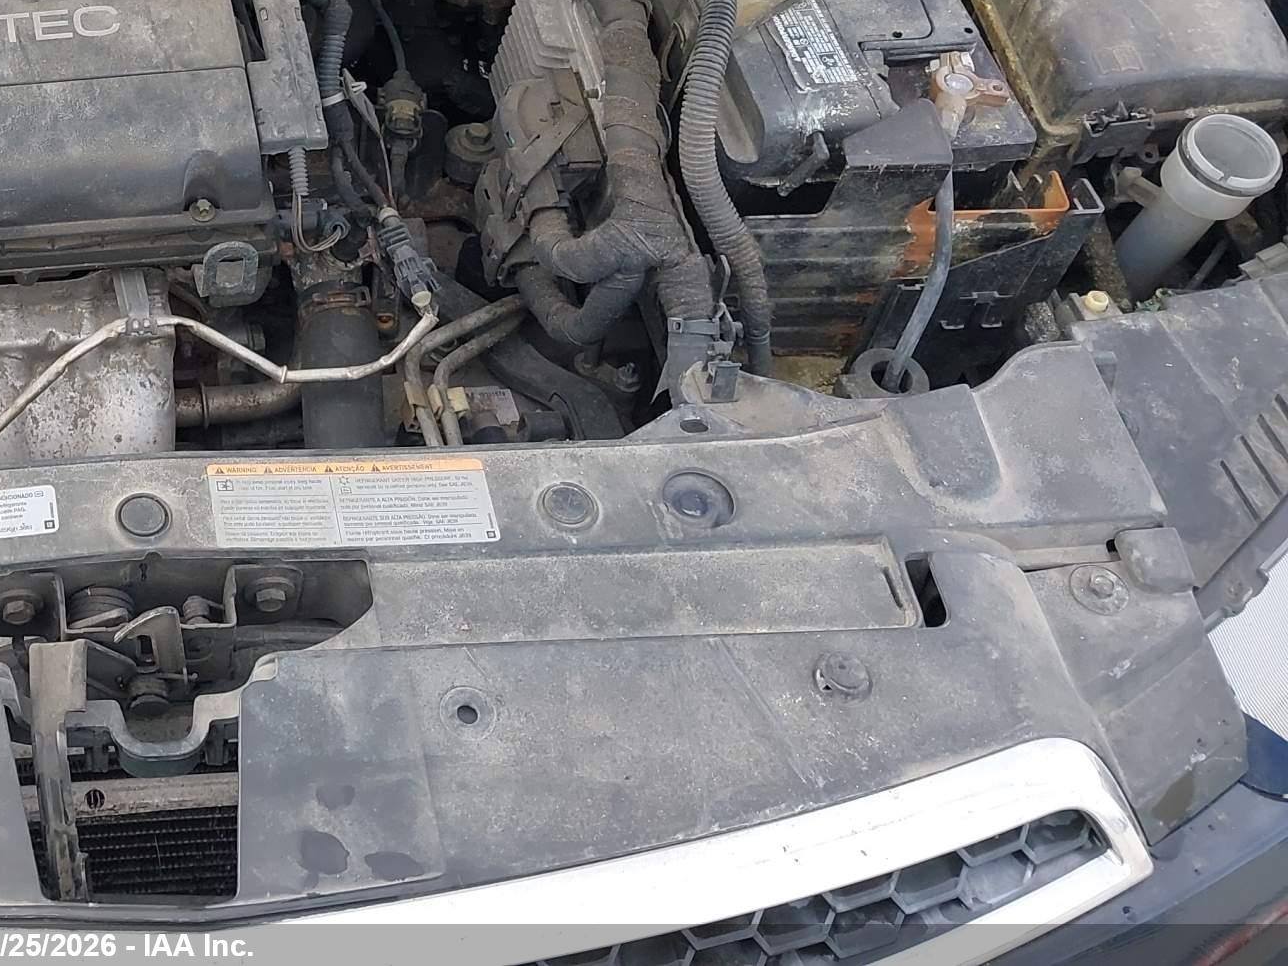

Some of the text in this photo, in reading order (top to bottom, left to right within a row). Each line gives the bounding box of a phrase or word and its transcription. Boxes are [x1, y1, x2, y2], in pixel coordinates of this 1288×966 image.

[226, 463, 433, 474] WARNING ADVERTENCIA ATENÇÃO AVERTISSEMENT
